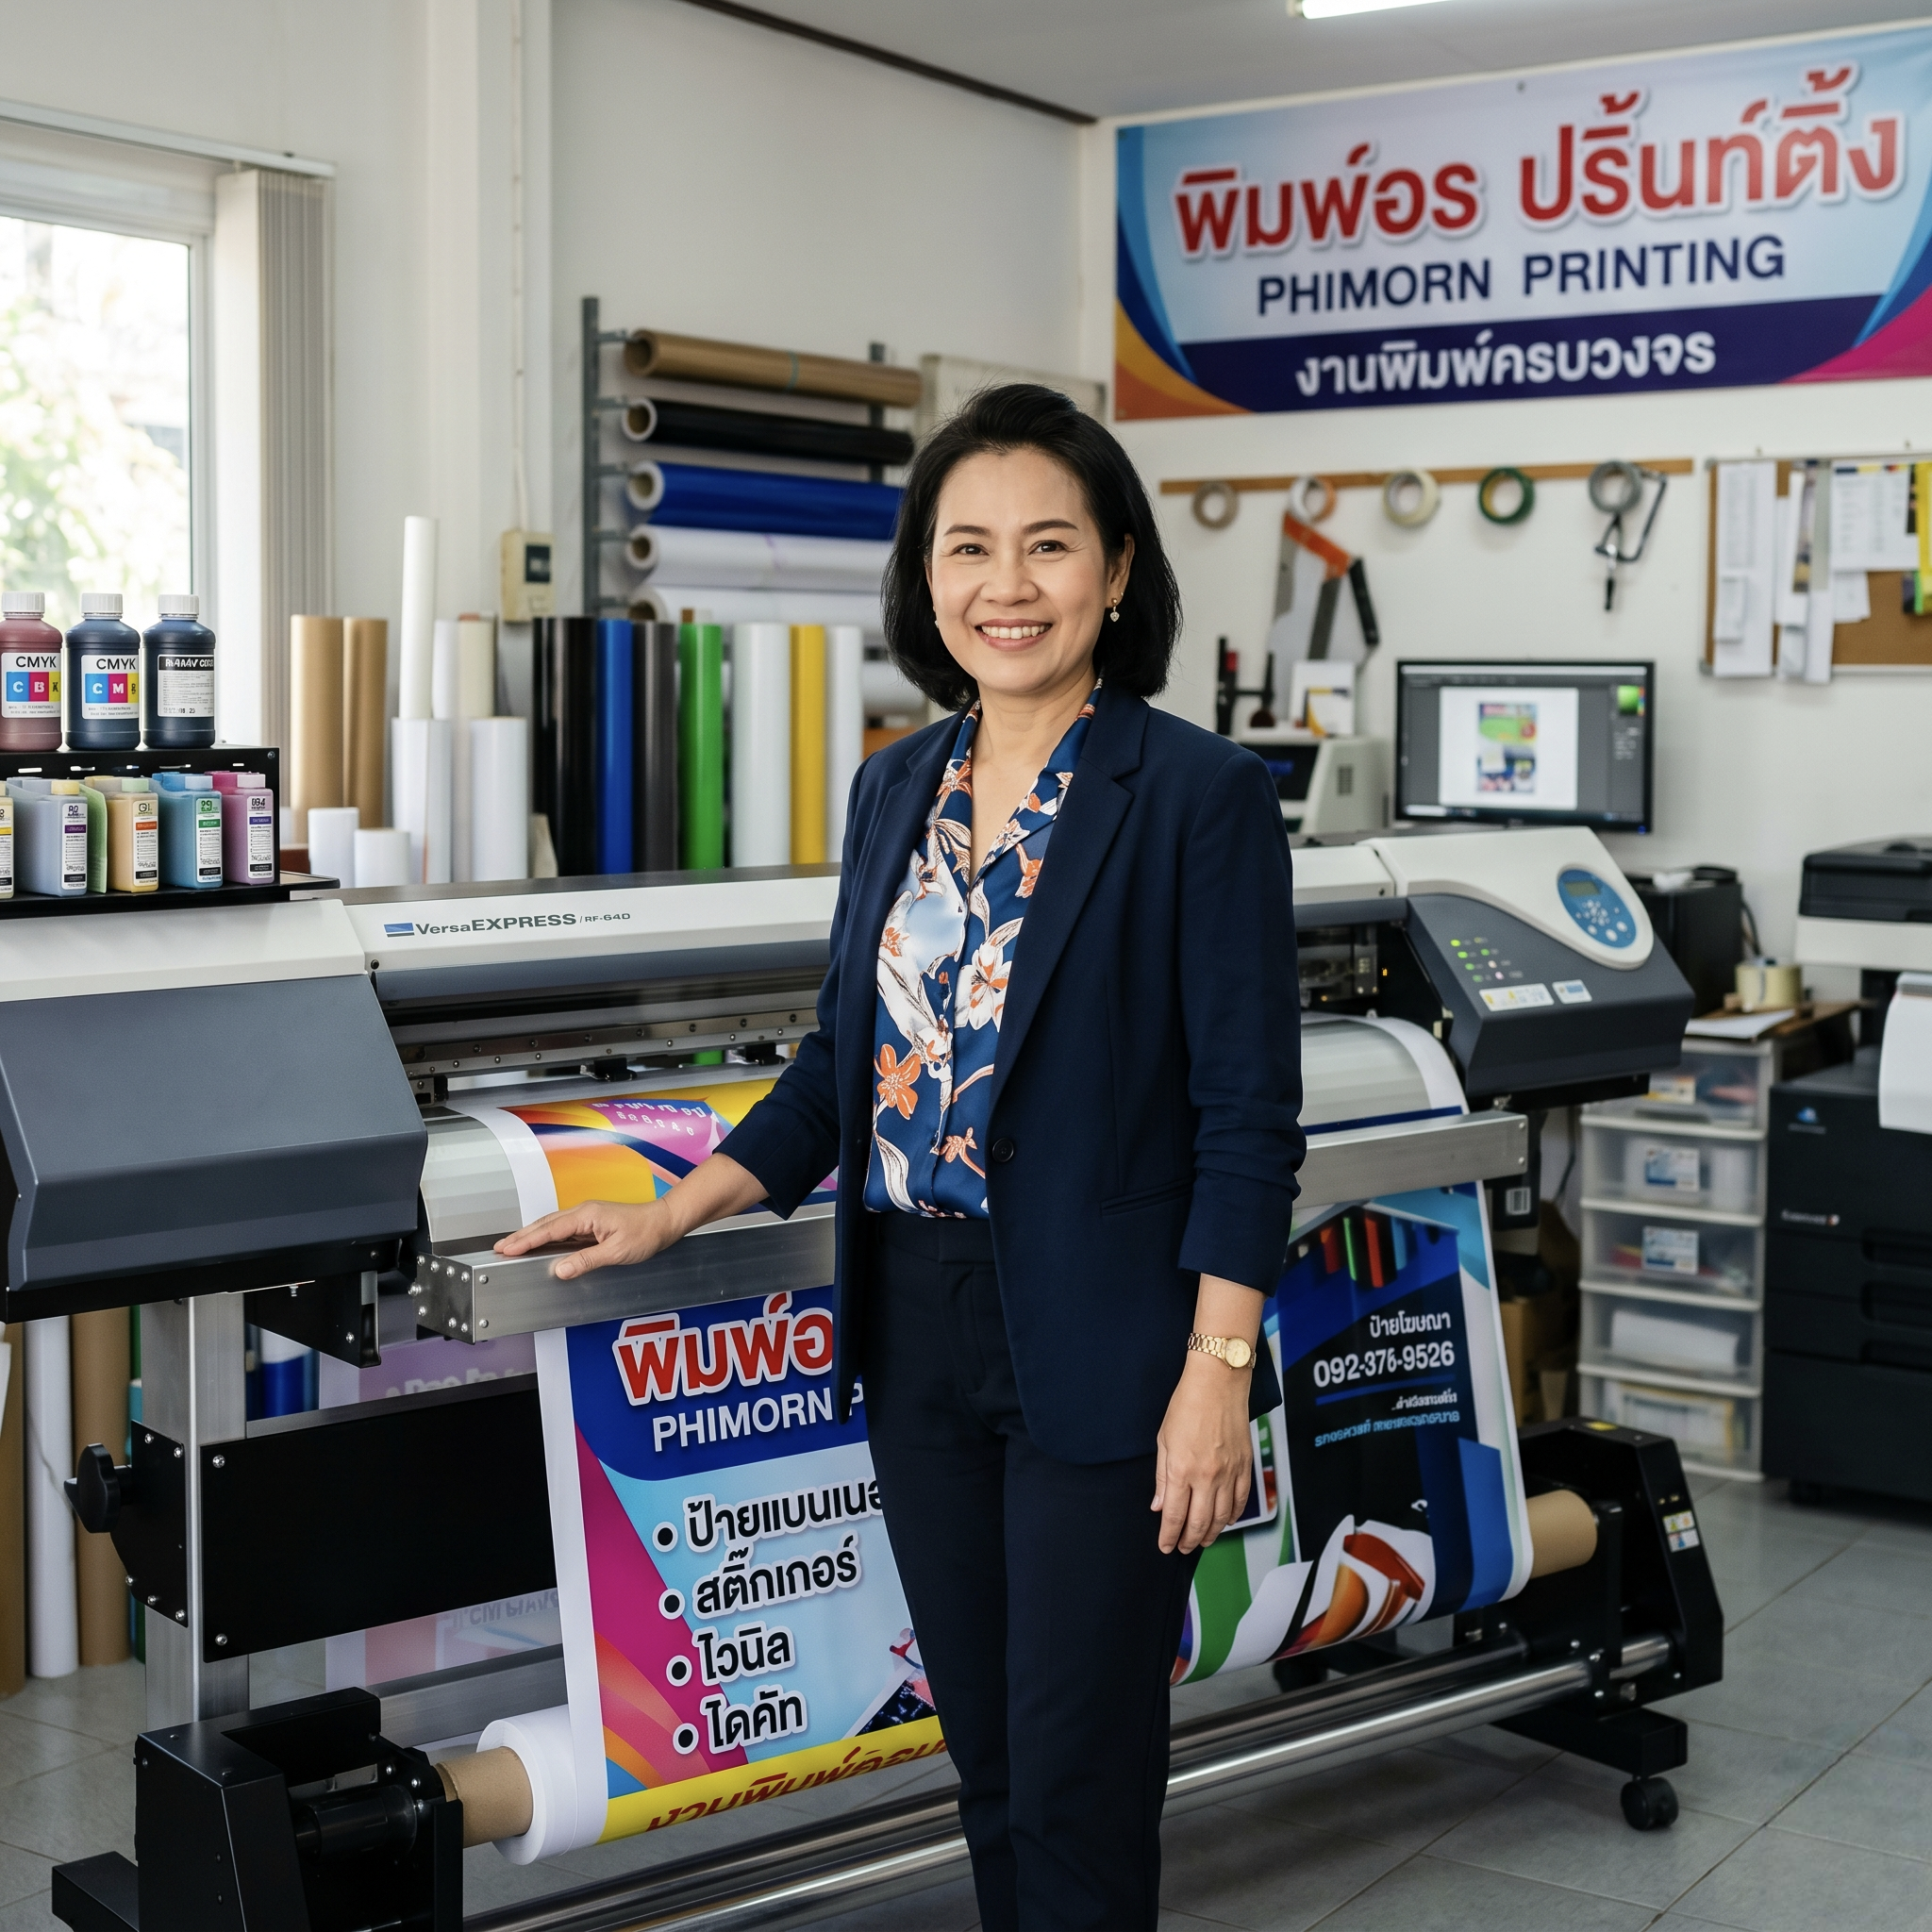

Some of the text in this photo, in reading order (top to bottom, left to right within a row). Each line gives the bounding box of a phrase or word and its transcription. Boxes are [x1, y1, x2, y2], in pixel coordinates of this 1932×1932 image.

[1175, 66, 1898, 254] พิมพ์อร ปริ้นท์ติ้ง
[1258, 235, 1785, 316] PHIMORN PRINTING
[1295, 329, 1716, 396] งานพิมพ์ครบวงจร
[15, 656, 57, 669] CMYK
[96, 658, 137, 670] CMYK
[112, 683, 125, 694] M
[415, 913, 576, 935] VersaEXPRESS
[653, 1387, 834, 1453] PHIMORN
[696, 1535, 857, 1614] สติ๊กเกอร์
[696, 1625, 791, 1680] ไวนิล
[705, 1690, 803, 1748] ไดคัท
